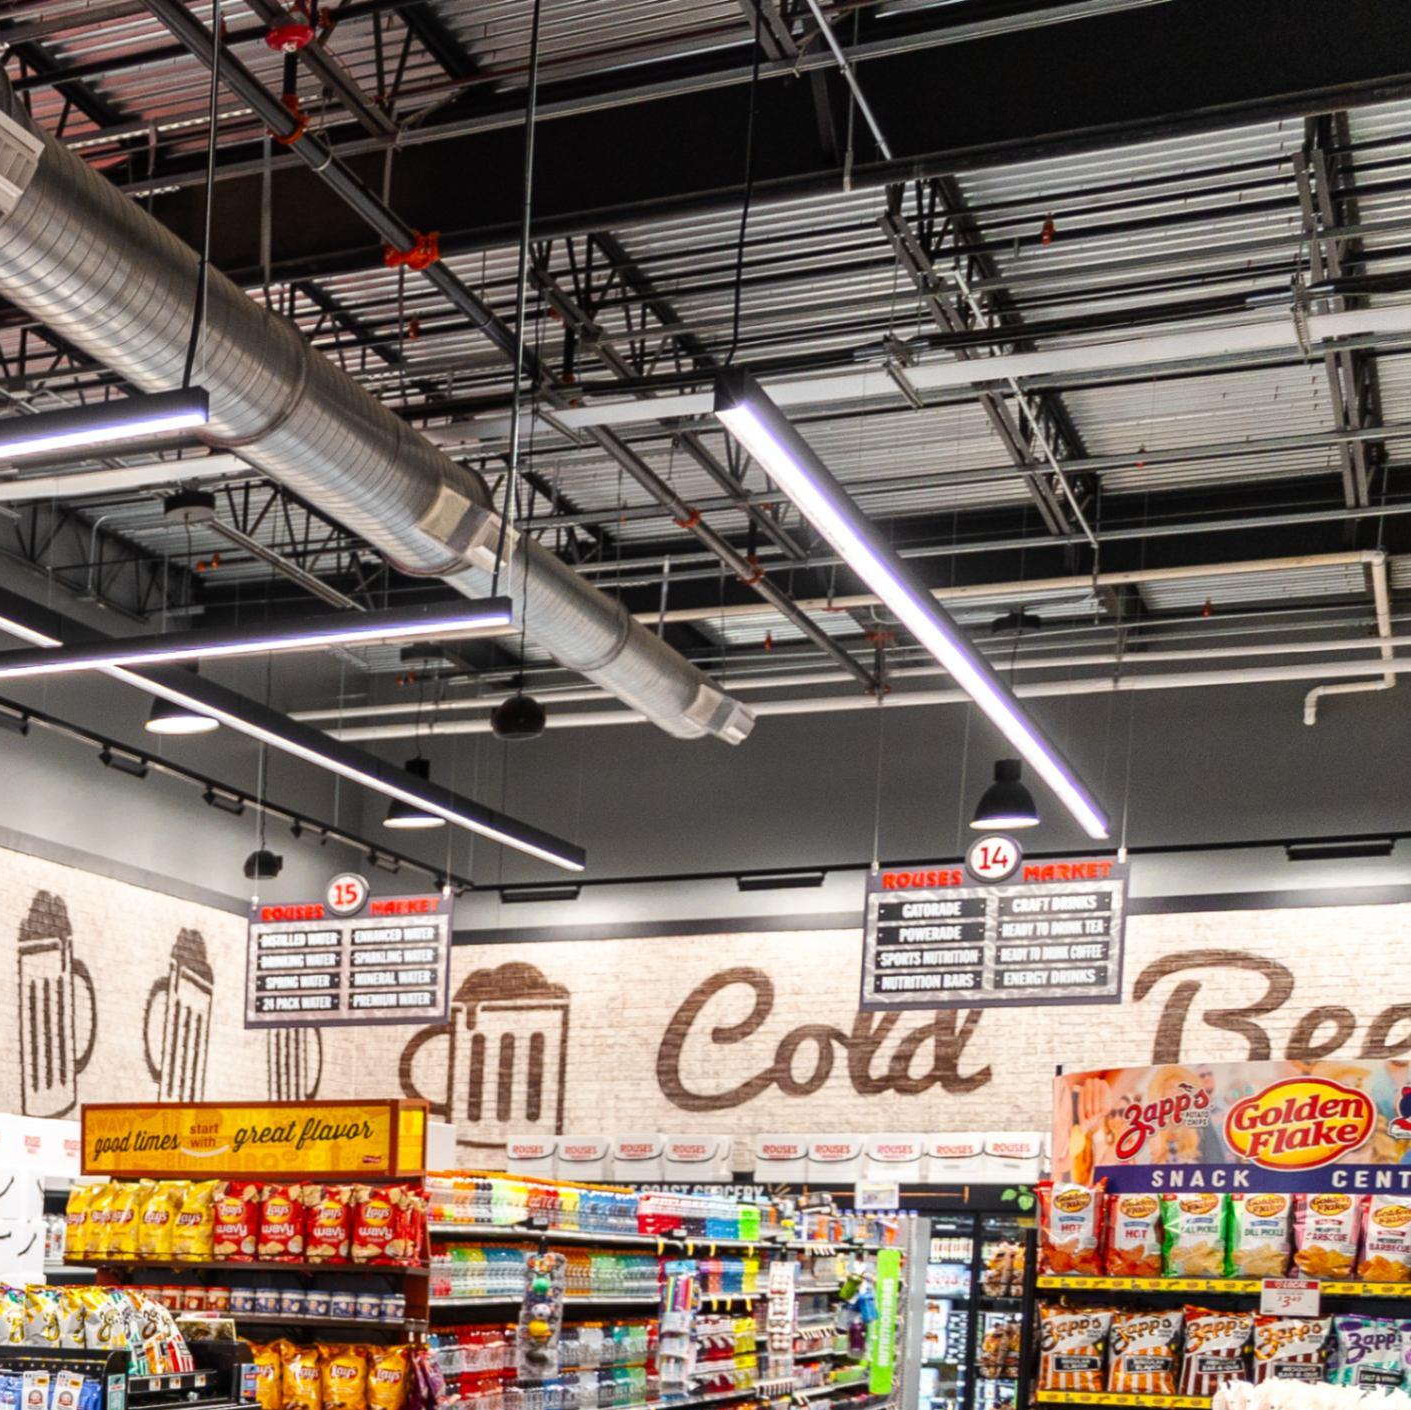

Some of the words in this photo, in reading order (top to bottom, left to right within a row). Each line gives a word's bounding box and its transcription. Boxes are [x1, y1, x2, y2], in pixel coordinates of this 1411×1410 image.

[979, 846, 1009, 870] 14
[882, 869, 963, 890] ROUSES
[1023, 861, 1114, 882] MARKET
[334, 883, 358, 905] 15
[1012, 897, 1049, 912] CRAFT
[1051, 895, 1097, 911] DRINKS
[261, 904, 325, 922] ROUSES
[369, 898, 440, 916] MARKET
[902, 901, 962, 919] GATORADE
[899, 926, 962, 943] POWERADE
[1001, 922, 1034, 938] READY
[1036, 921, 1050, 937] TO
[1051, 920, 1084, 935] DRINK
[1085, 918, 1104, 934] TEA
[880, 951, 921, 967] SPORTS
[922, 949, 978, 966] NUTRITION
[881, 973, 941, 991] NUTRITION
[943, 972, 974, 988] BARS
[1003, 969, 1049, 986] ENERGY
[1050, 966, 1096, 984] DRINKS
[656, 967, 993, 1113] Cold
[1232, 1094, 1365, 1128] Golden
[189, 1122, 219, 1135] start
[233, 1123, 293, 1152] great
[295, 1117, 375, 1150] flavor
[93, 1130, 131, 1161] good
[133, 1131, 180, 1151] times
[190, 1136, 217, 1148] with
[1245, 1121, 1360, 1159] Flake
[1151, 1169, 1251, 1188] SNACK
[1125, 1229, 1147, 1239] HOT
